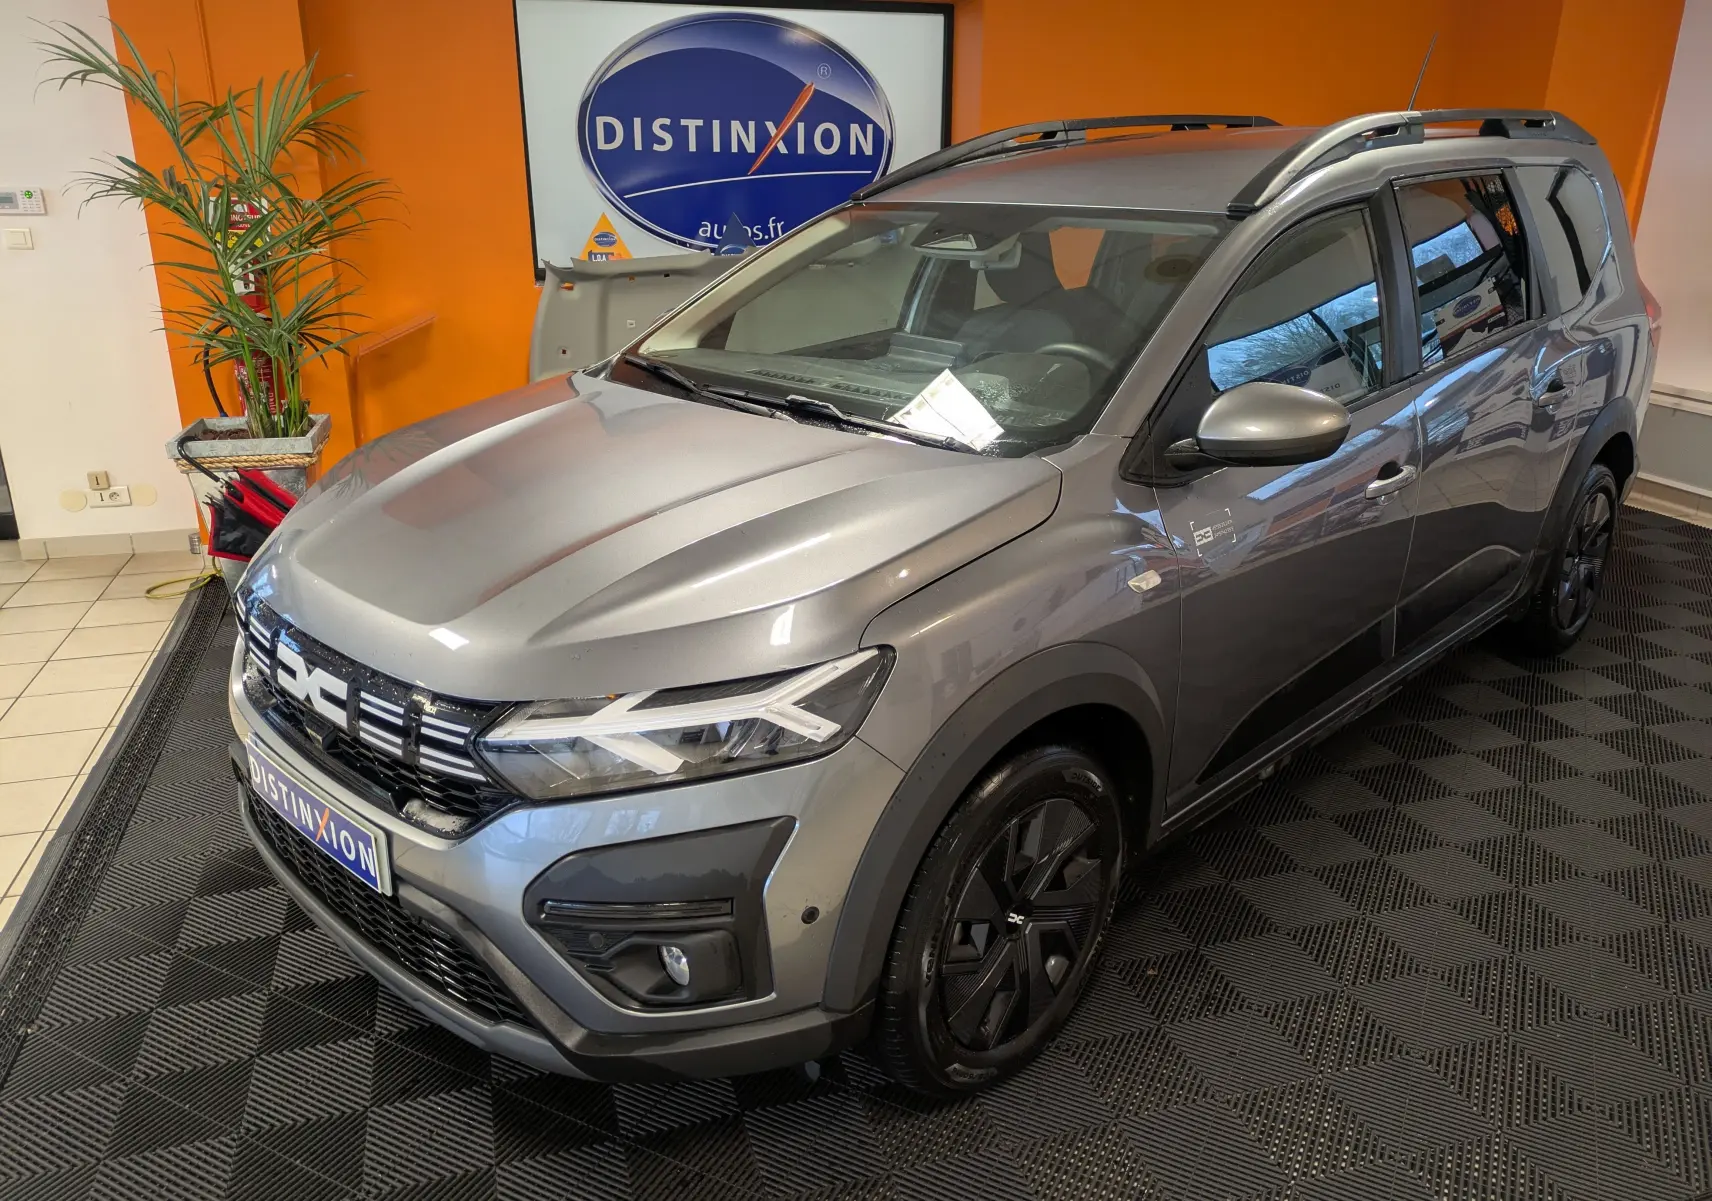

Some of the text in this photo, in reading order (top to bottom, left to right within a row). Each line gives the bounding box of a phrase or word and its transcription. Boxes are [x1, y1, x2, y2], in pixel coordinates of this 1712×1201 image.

[595, 115, 874, 157] DISTINXION
[698, 216, 785, 241] aus.fr
[250, 754, 376, 878] DISTINXION
